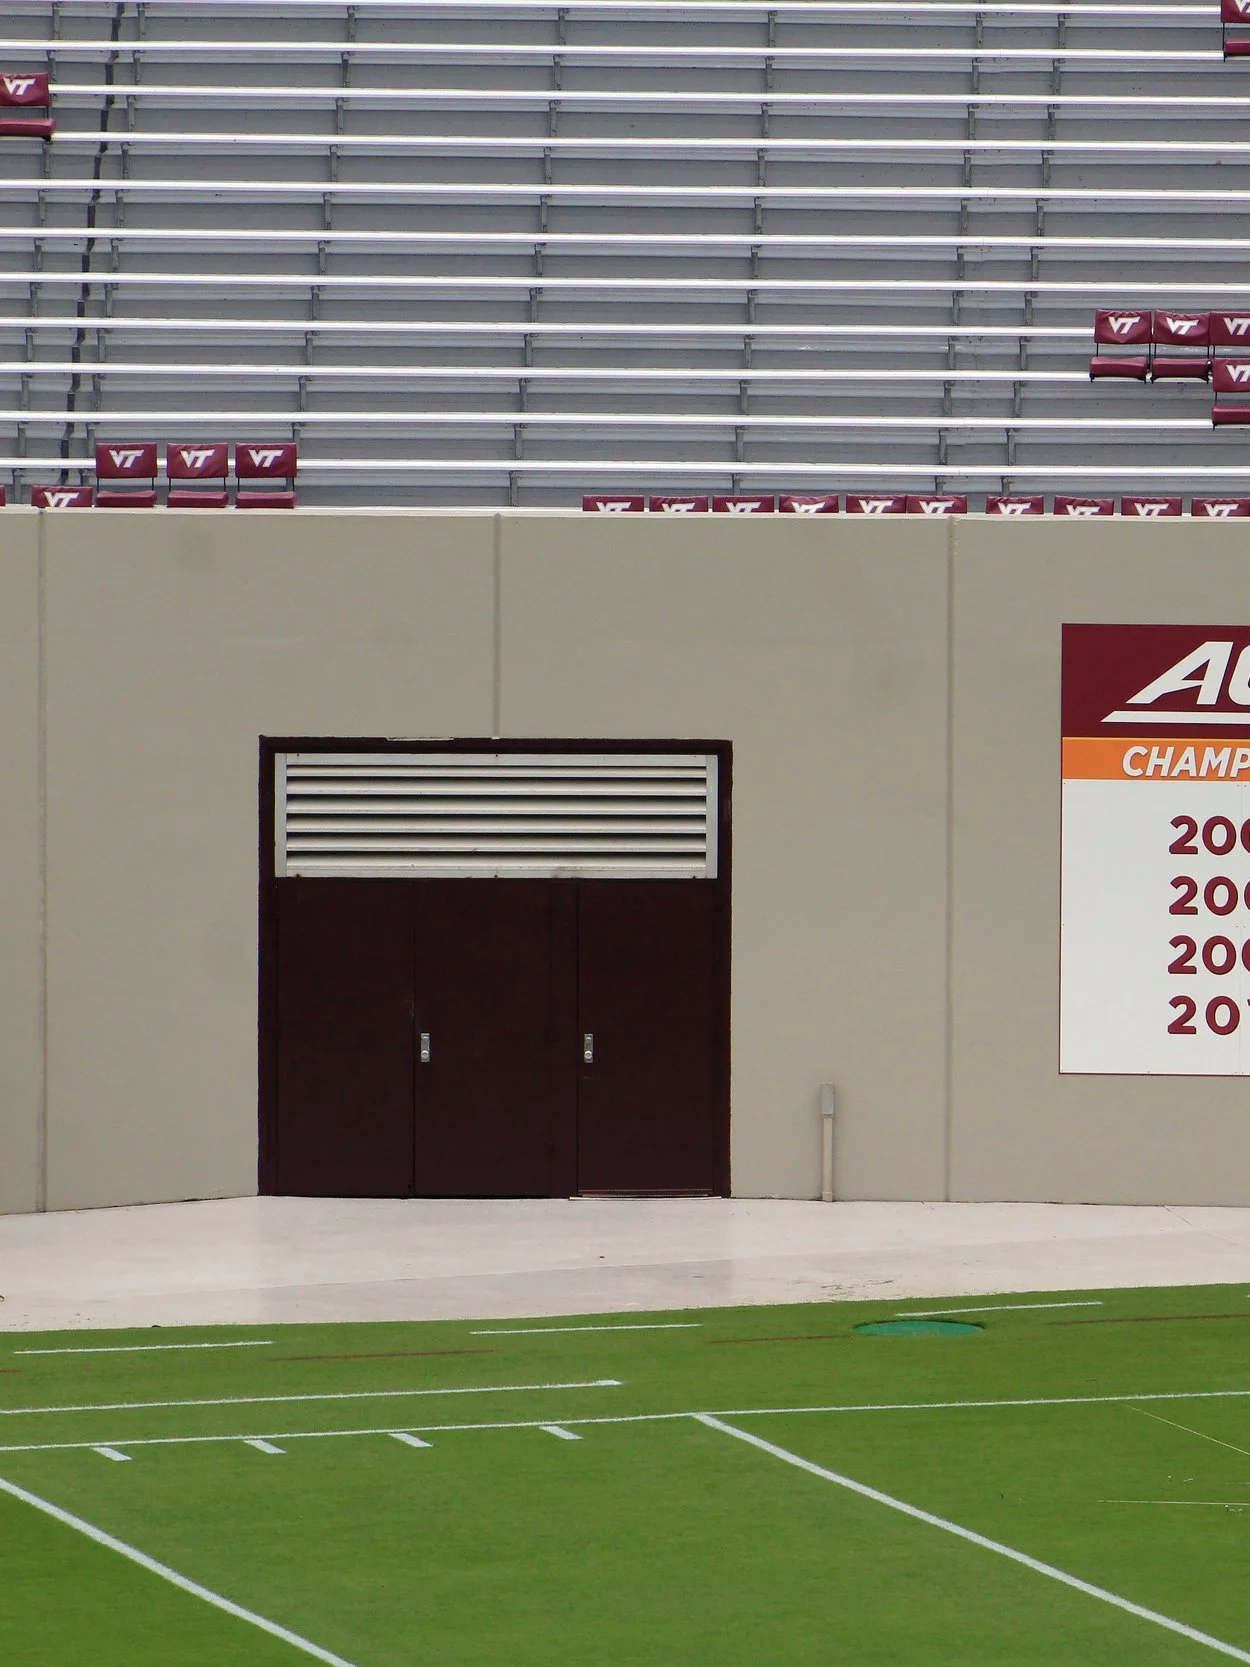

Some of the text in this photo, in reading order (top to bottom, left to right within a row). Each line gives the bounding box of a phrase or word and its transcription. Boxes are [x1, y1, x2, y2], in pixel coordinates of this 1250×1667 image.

[2, 77, 36, 95] VT
[1108, 316, 1141, 334] VT
[1165, 316, 1200, 335] VT
[109, 449, 145, 468] VT
[180, 449, 215, 467] VT
[248, 449, 284, 467] VT
[43, 491, 80, 507] VT
[858, 499, 894, 513] VT
[1134, 502, 1169, 516] VT
[1204, 503, 1239, 517] VT
